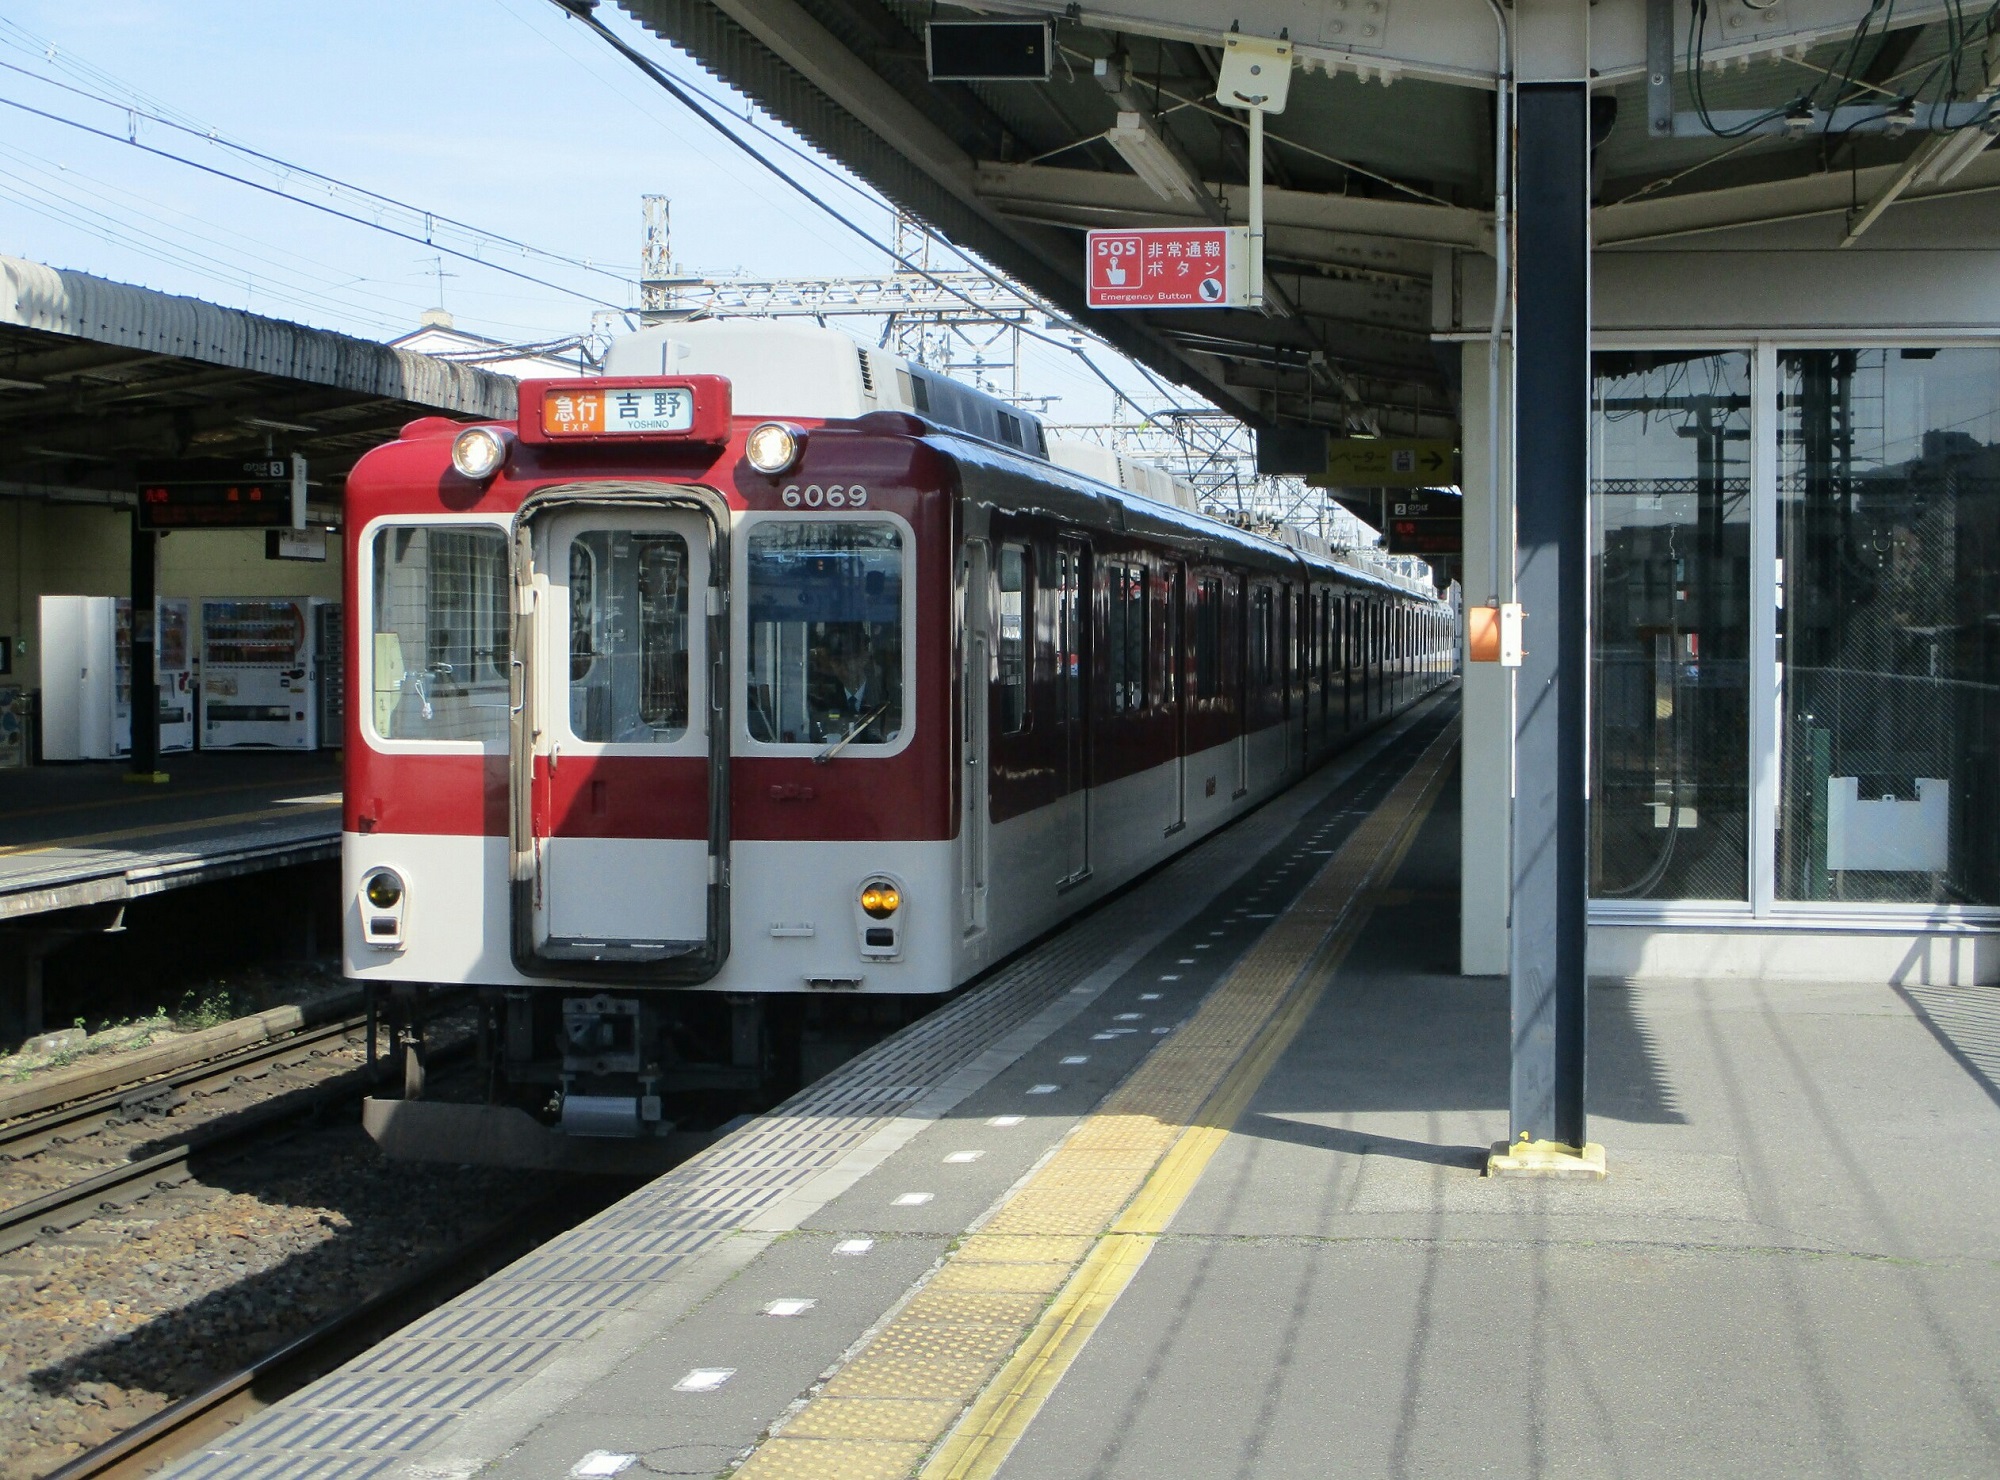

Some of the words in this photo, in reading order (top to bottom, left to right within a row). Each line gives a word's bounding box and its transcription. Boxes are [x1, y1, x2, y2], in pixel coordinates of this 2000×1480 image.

[1097, 241, 1136, 256] SOS
[1147, 240, 1221, 258] 非常通報
[1147, 260, 1220, 277] ボタン
[1100, 292, 1155, 302] Emergency
[1158, 291, 1192, 300] Button
[554, 395, 598, 423] 急行
[615, 392, 682, 419] 吉野
[627, 419, 669, 430] YOSHINO
[781, 484, 868, 508] 6069
